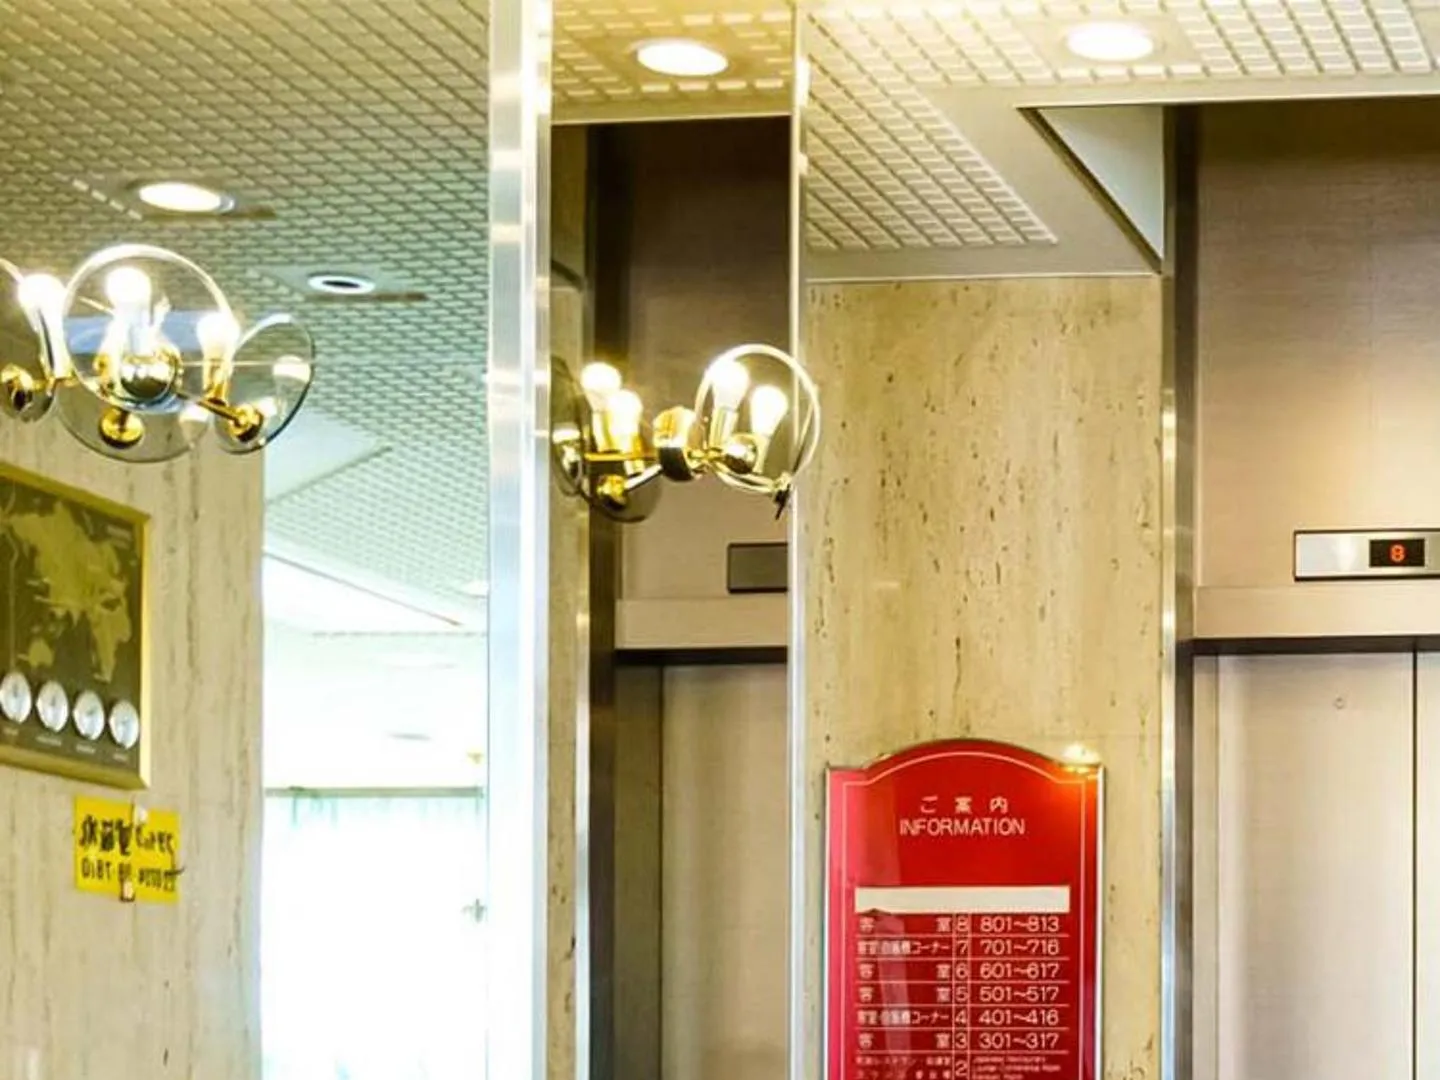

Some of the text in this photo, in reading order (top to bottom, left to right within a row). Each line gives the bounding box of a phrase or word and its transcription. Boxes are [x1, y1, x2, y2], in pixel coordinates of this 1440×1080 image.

[920, 795, 1008, 814] ご案内
[900, 818, 1025, 836] INFORMATION
[956, 917, 968, 932] 8
[956, 940, 968, 955] 7
[956, 963, 968, 979] 6
[956, 986, 968, 1002] 5
[956, 1009, 968, 1025] 4
[956, 1033, 968, 1049] 3
[956, 1061, 968, 1077] 2
